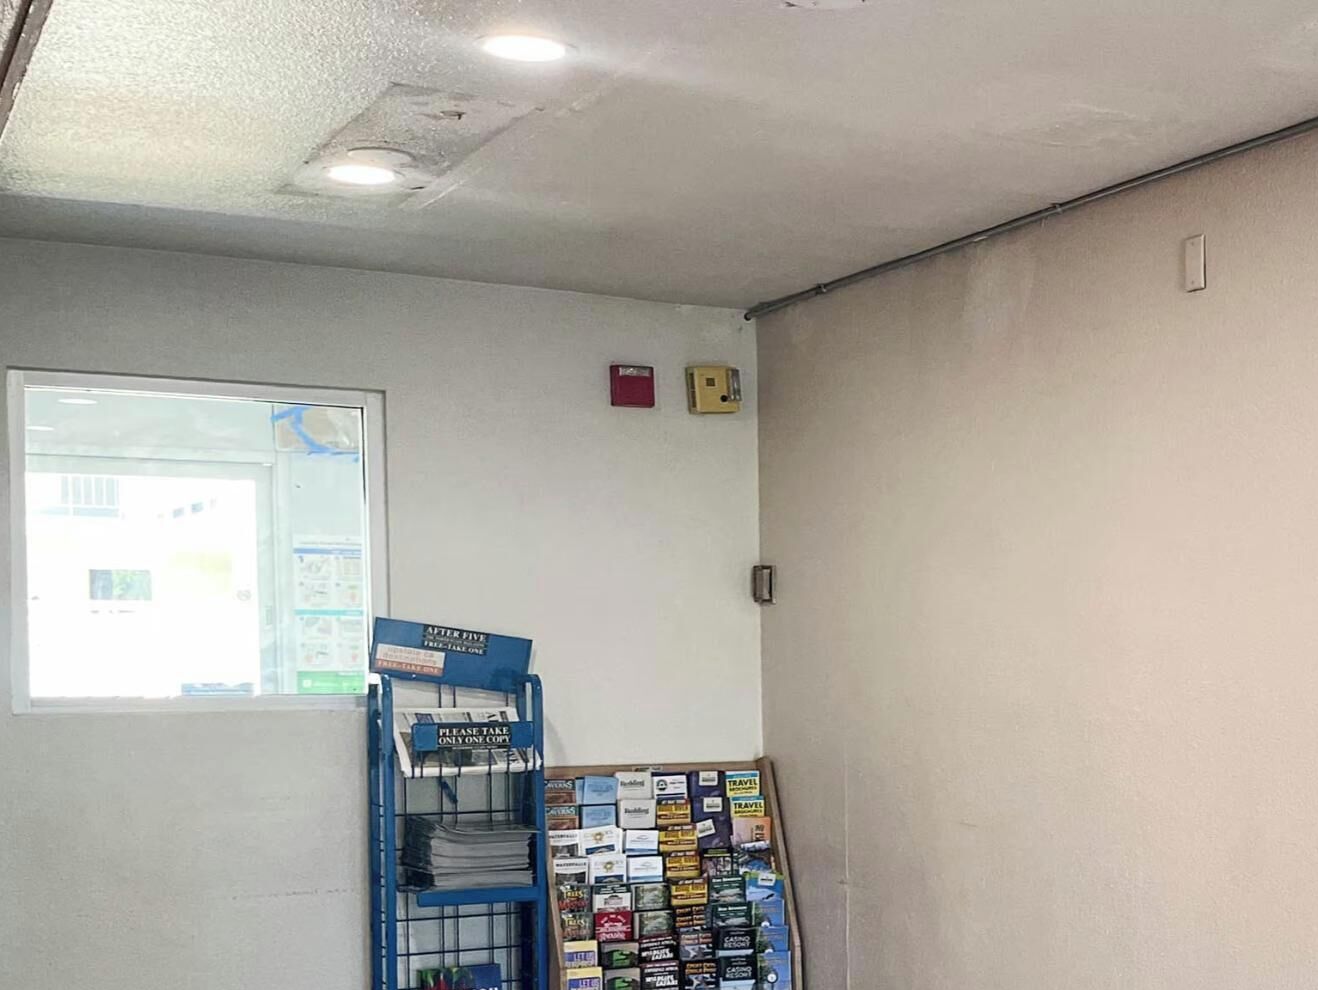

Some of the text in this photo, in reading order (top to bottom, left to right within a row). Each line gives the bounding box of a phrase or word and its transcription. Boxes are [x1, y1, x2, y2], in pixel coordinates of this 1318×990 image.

[426, 626, 460, 639] AFTER
[462, 631, 487, 641] FIVE
[467, 647, 484, 655] ONE
[439, 726, 509, 736] PLEASE TAKE
[438, 735, 511, 745] ONLY ONE COPY
[728, 778, 758, 786] TRAVEL
[733, 801, 764, 809] TRAVEL
